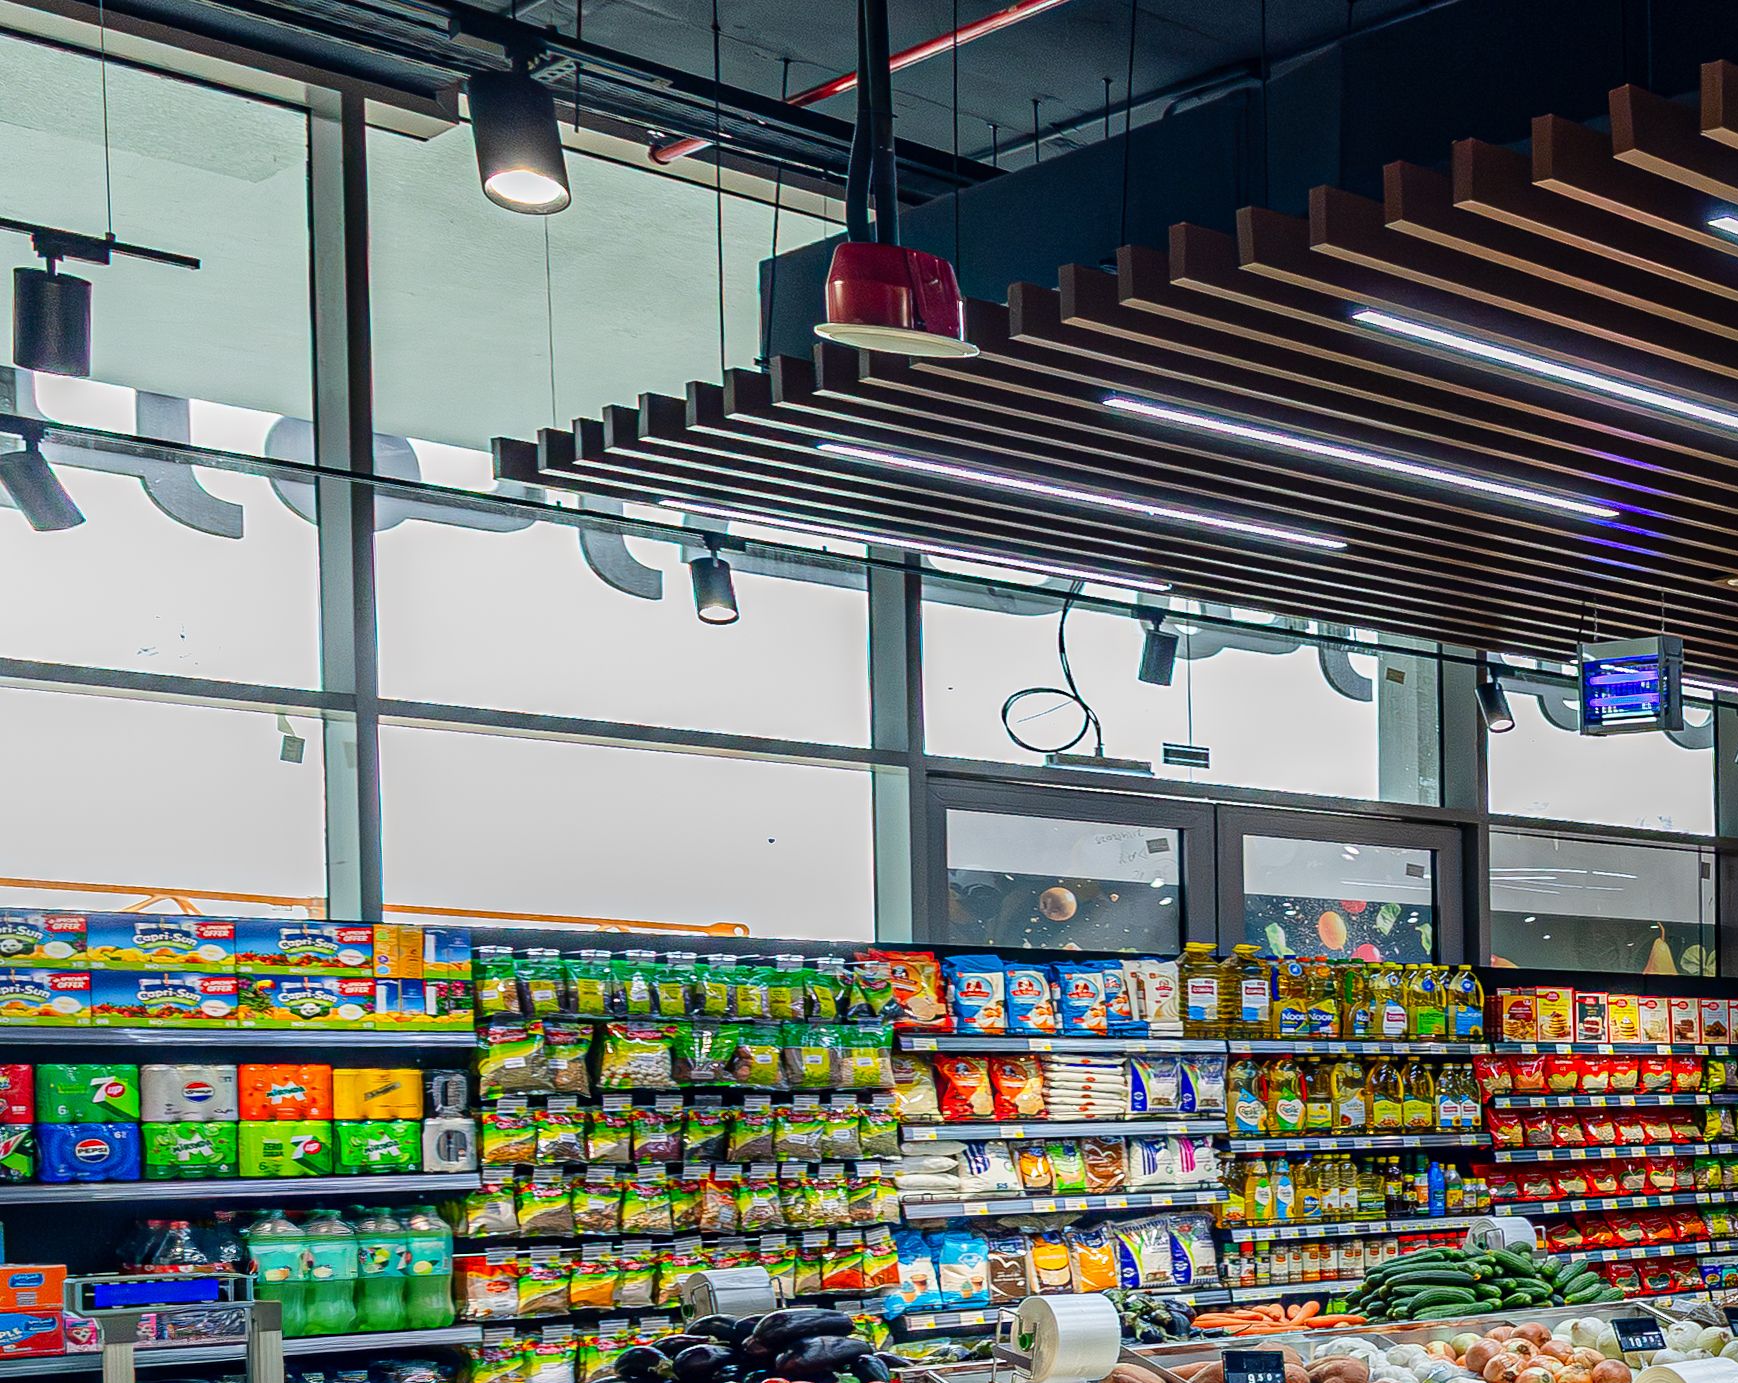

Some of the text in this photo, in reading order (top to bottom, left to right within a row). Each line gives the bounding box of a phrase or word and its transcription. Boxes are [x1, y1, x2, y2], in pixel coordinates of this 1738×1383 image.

[132, 931, 198, 947] Capri-Sun
[278, 937, 339, 951] Capri-Sun
[136, 987, 201, 1002] Capri-Sun
[278, 989, 338, 1003] Capri-Sun
